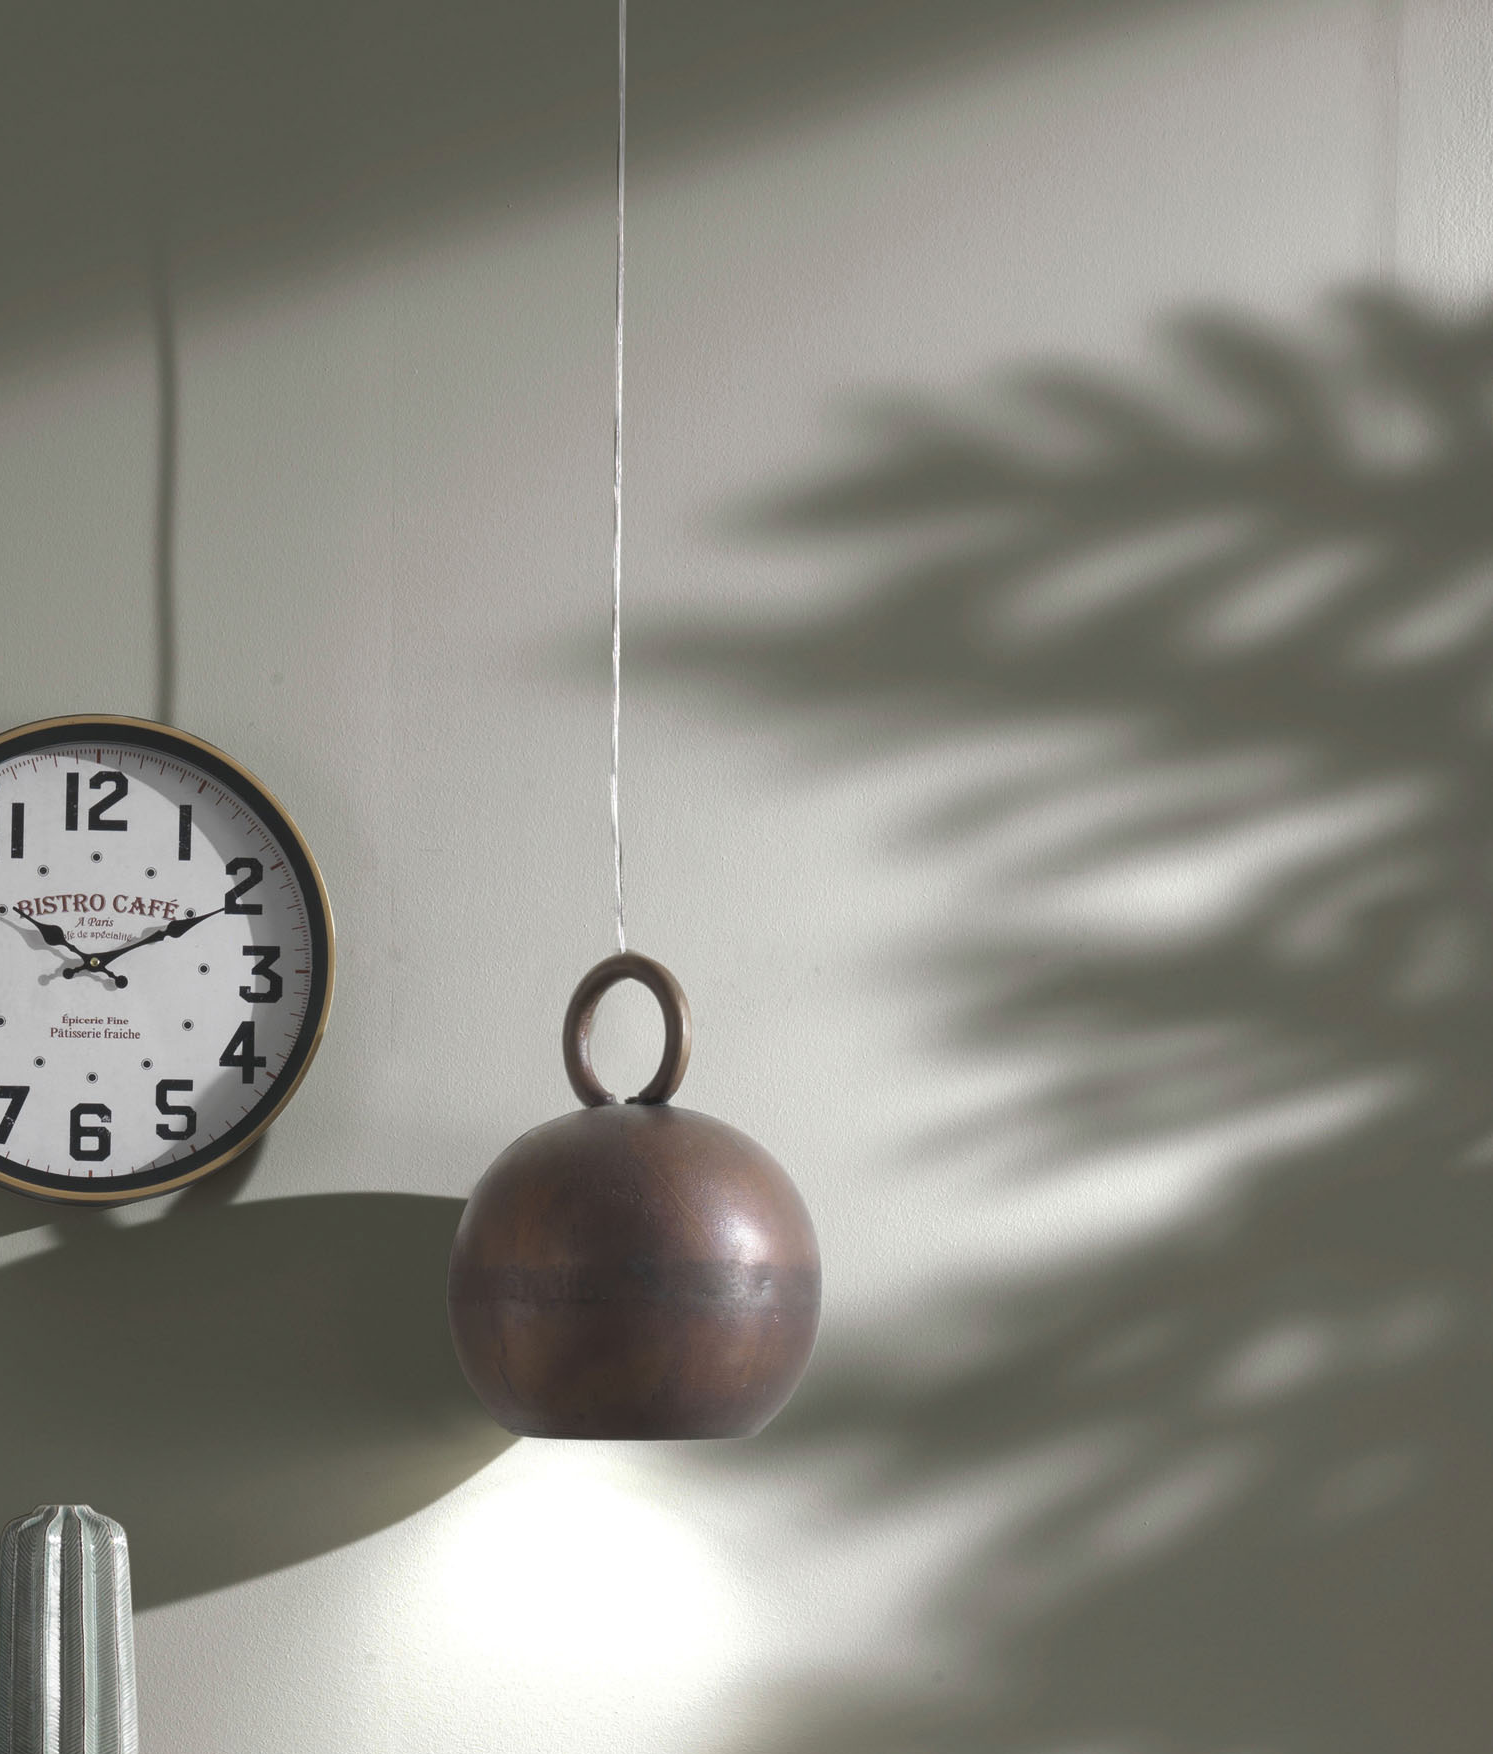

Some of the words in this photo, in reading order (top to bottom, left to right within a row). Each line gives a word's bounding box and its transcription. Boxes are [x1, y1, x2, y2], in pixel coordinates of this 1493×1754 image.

[65, 771, 128, 831] 12
[178, 805, 192, 860] 1
[17, 893, 106, 919] BISTRO
[112, 894, 179, 921] CAFÉ
[224, 857, 263, 915] 2
[77, 930, 87, 939] de
[88, 917, 114, 927] Paris
[239, 945, 283, 1003] 3
[50, 1027, 102, 1038] Pâtisserie
[104, 1027, 140, 1039] fraiche
[62, 1014, 104, 1025] Épicerie
[106, 1016, 129, 1025] Fine
[219, 1021, 266, 1084] 4
[69, 1103, 112, 1162] 6
[156, 1079, 197, 1141] 5
